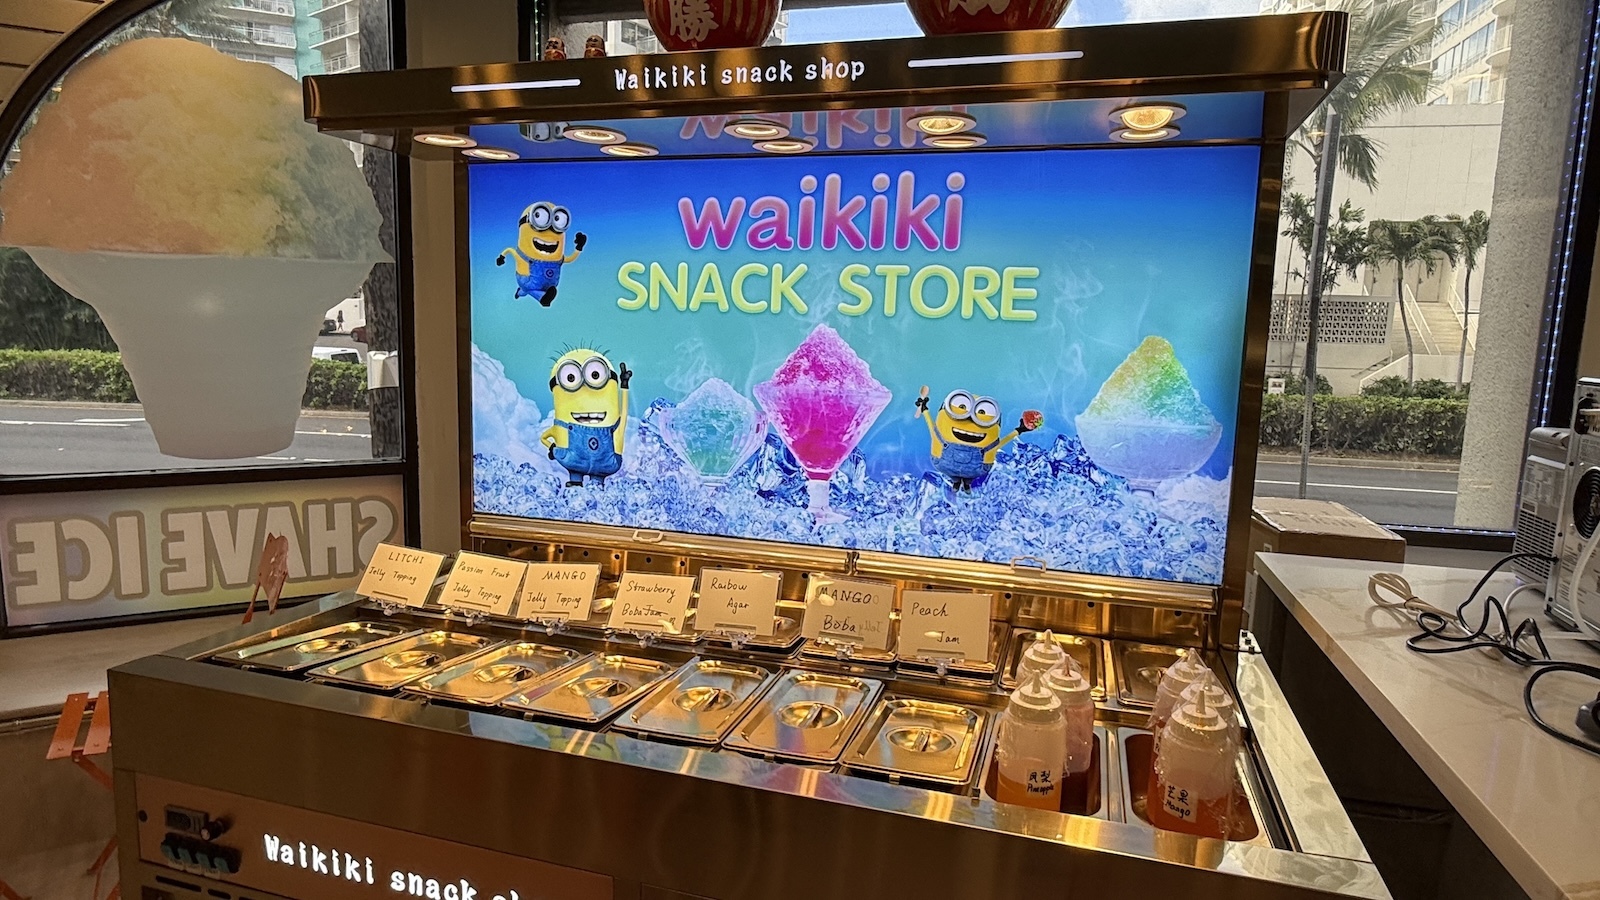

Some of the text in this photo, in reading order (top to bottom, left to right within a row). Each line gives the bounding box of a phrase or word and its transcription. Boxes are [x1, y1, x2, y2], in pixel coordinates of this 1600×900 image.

[614, 56, 865, 90] Waikiki snack shop
[678, 170, 966, 252] waikiki
[616, 261, 1040, 322] SNACK STORE
[388, 551, 425, 564] LITCHI
[368, 566, 418, 585] Jelly Topping
[457, 561, 511, 579] Passion Fruit
[541, 570, 587, 581] MANGO
[453, 582, 502, 604] Jelly Topping
[526, 591, 582, 610] Jelly Topping
[626, 581, 676, 604] Strawberry
[726, 597, 750, 615] Agar
[911, 602, 949, 617] Peach
[936, 630, 961, 645] Jam
[1167, 785, 1190, 806] 芒果
[1164, 799, 1191, 819] Mango
[264, 833, 375, 885] Waikiki
[390, 870, 478, 900] snack
